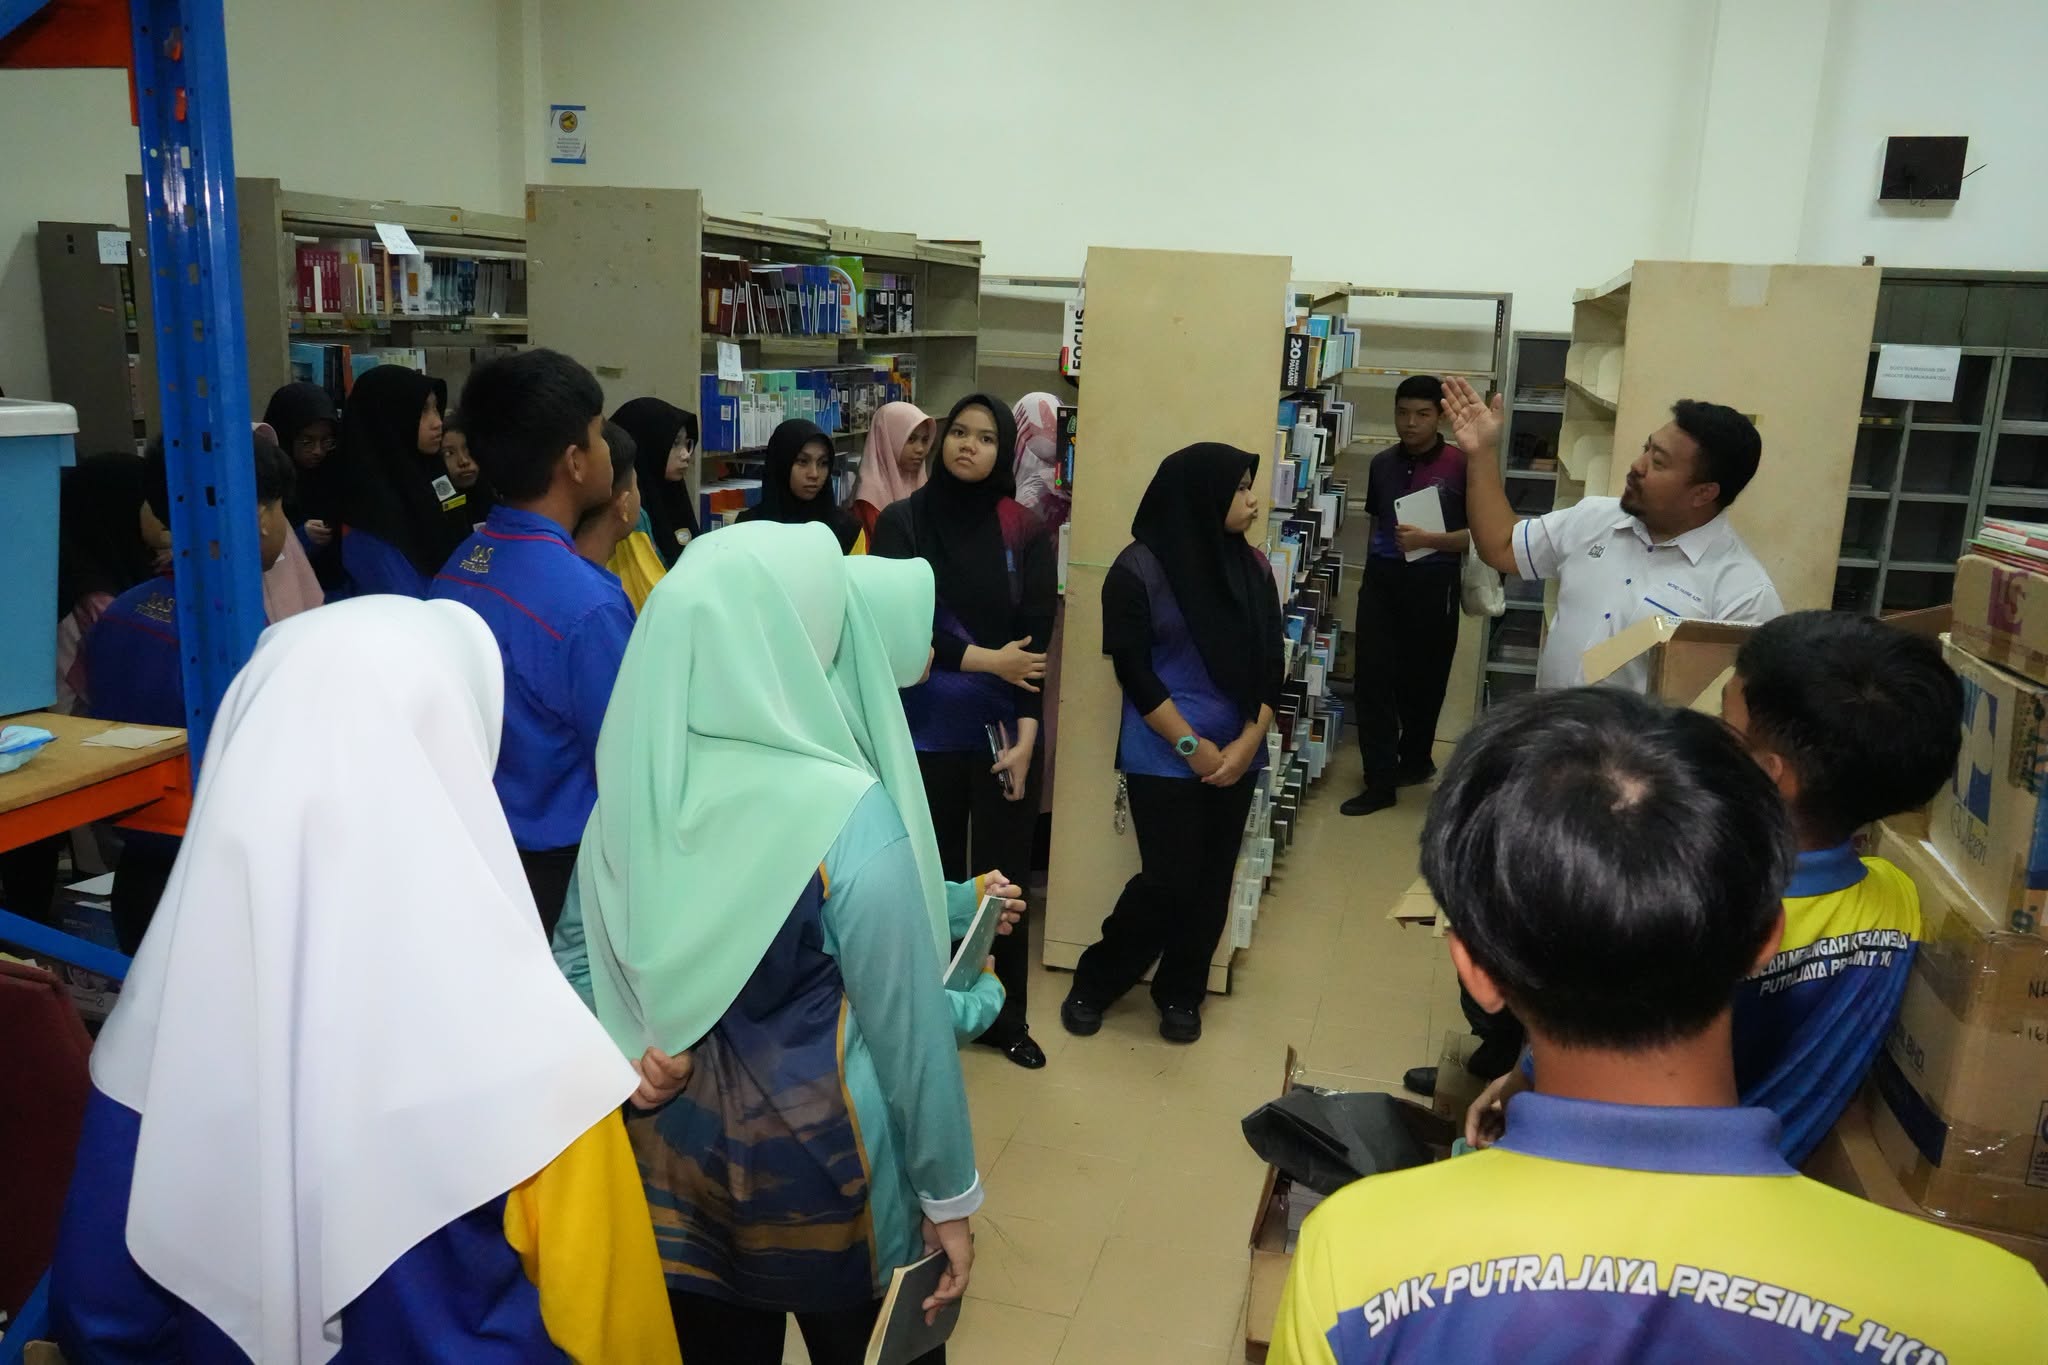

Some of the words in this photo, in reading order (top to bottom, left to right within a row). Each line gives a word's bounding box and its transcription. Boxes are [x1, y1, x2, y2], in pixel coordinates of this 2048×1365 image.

[1290, 337, 1303, 360] 20
[1362, 1274, 1436, 1339] SMK
[1443, 1253, 1659, 1306] PUTRAJAYA
[1668, 1264, 1855, 1341] PRESINT
